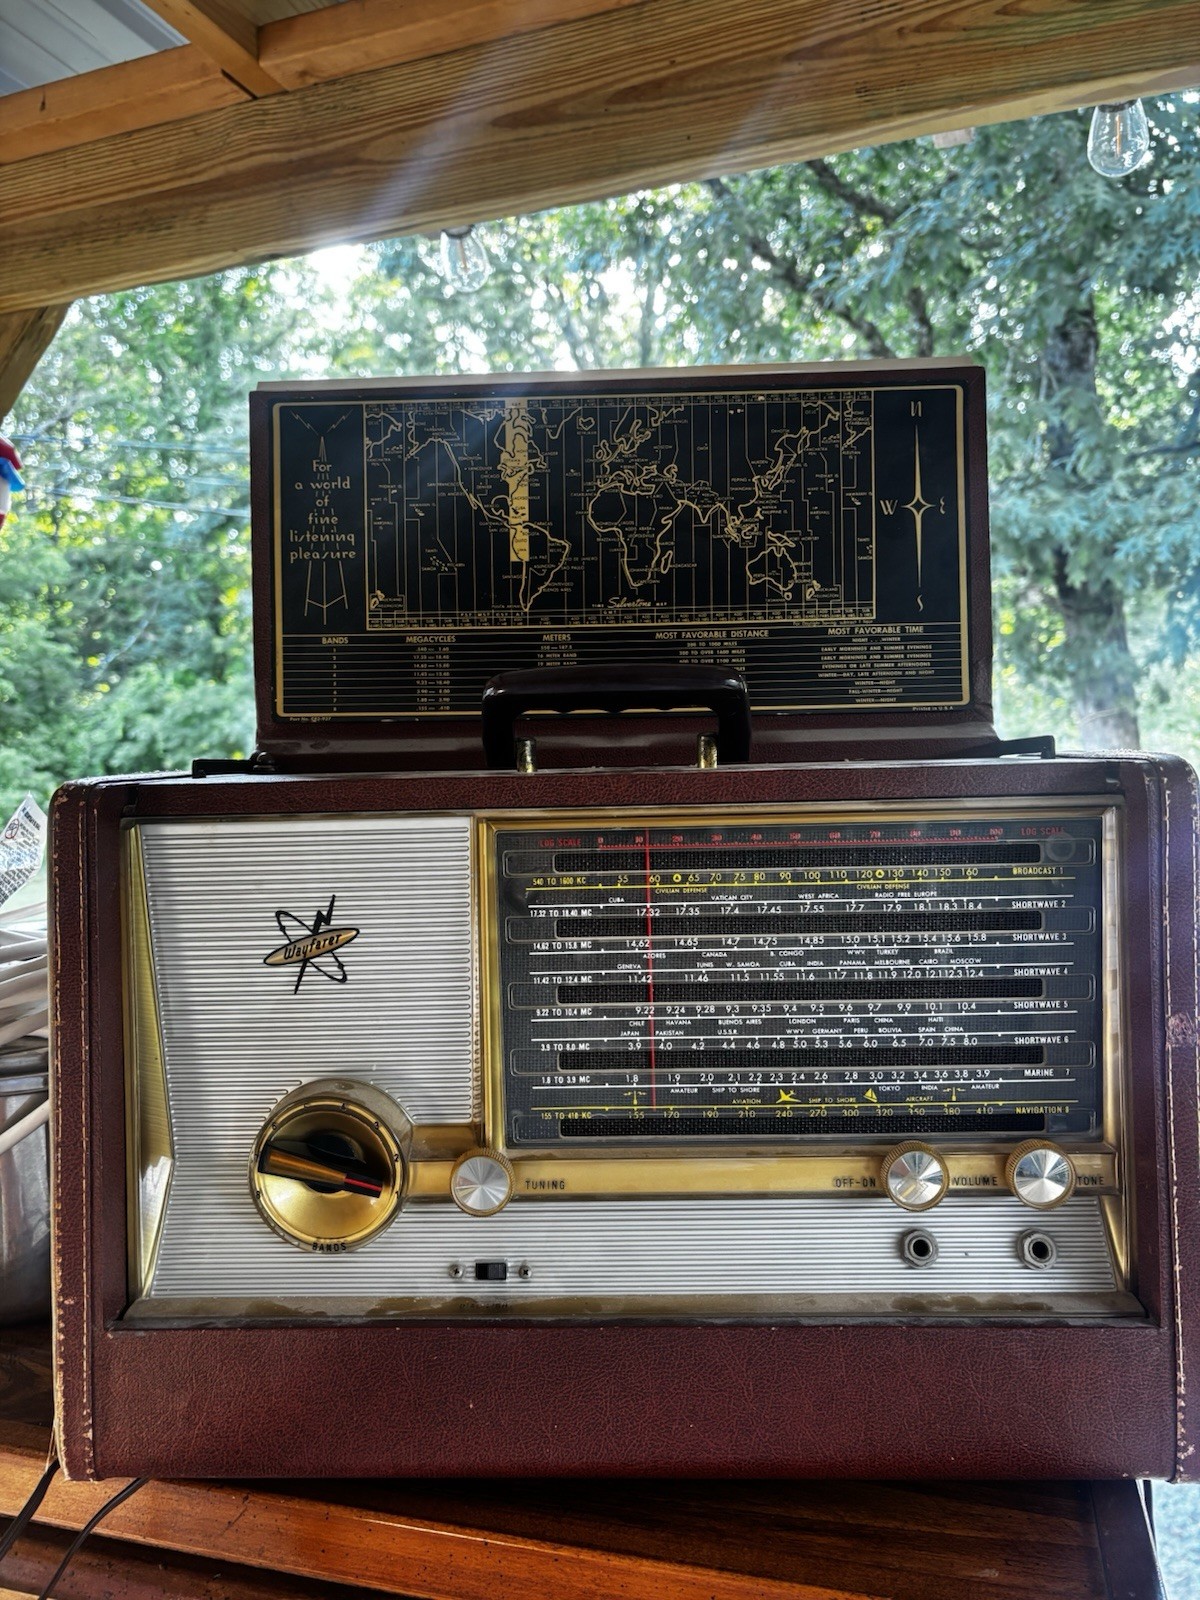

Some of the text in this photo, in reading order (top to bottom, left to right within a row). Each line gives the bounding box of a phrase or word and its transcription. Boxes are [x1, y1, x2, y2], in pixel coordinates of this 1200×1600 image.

[312, 460, 332, 472] For
[295, 476, 351, 490] a world
[316, 495, 329, 507] of
[880, 500, 898, 515] W
[308, 513, 338, 524] fine
[290, 529, 355, 546] listening
[290, 546, 356, 564] pleasure
[607, 597, 652, 608] Silvertone
[655, 629, 770, 640] MOST FAVORABLE DISTANCE
[828, 627, 851, 635] MOST
[854, 626, 901, 635] FAVORABLE
[322, 636, 349, 645] BANDS
[617, 875, 628, 883] 55
[688, 874, 700, 882] 65
[709, 873, 722, 881] 70
[733, 873, 745, 881] 75
[780, 872, 791, 880] 90
[856, 870, 873, 878] 120
[887, 869, 904, 877] 130
[911, 869, 928, 877] 140
[961, 868, 978, 876] 160
[1012, 867, 1057, 875] BROADCAST
[532, 878, 543, 886] 540
[1012, 901, 1059, 909] SHORTWAVE
[1013, 933, 1060, 941] SHORTWAVE
[284, 934, 342, 960] Wayfarer
[1014, 968, 1061, 976] SHORTWAVE
[636, 1002, 976, 1014] 9.22 9.24 9.28 9.3 9.35 9.4 9.5 9.6 9.7 9.9 10.1 10.4
[1013, 1001, 1061, 1009] SHORTWAVE
[536, 1009, 549, 1017] 9.22
[565, 1008, 578, 1016] 10.4
[1014, 1036, 1061, 1044] SHORTWAVE
[1024, 1069, 1054, 1077] MARINE
[1016, 1106, 1062, 1114] NAVIGATION
[525, 1180, 565, 1190] TUNING
[835, 1178, 876, 1187] OFF-ON
[953, 1177, 998, 1186] VOLUME
[1077, 1176, 1104, 1185] TONE
[312, 1242, 347, 1251] BANDS
